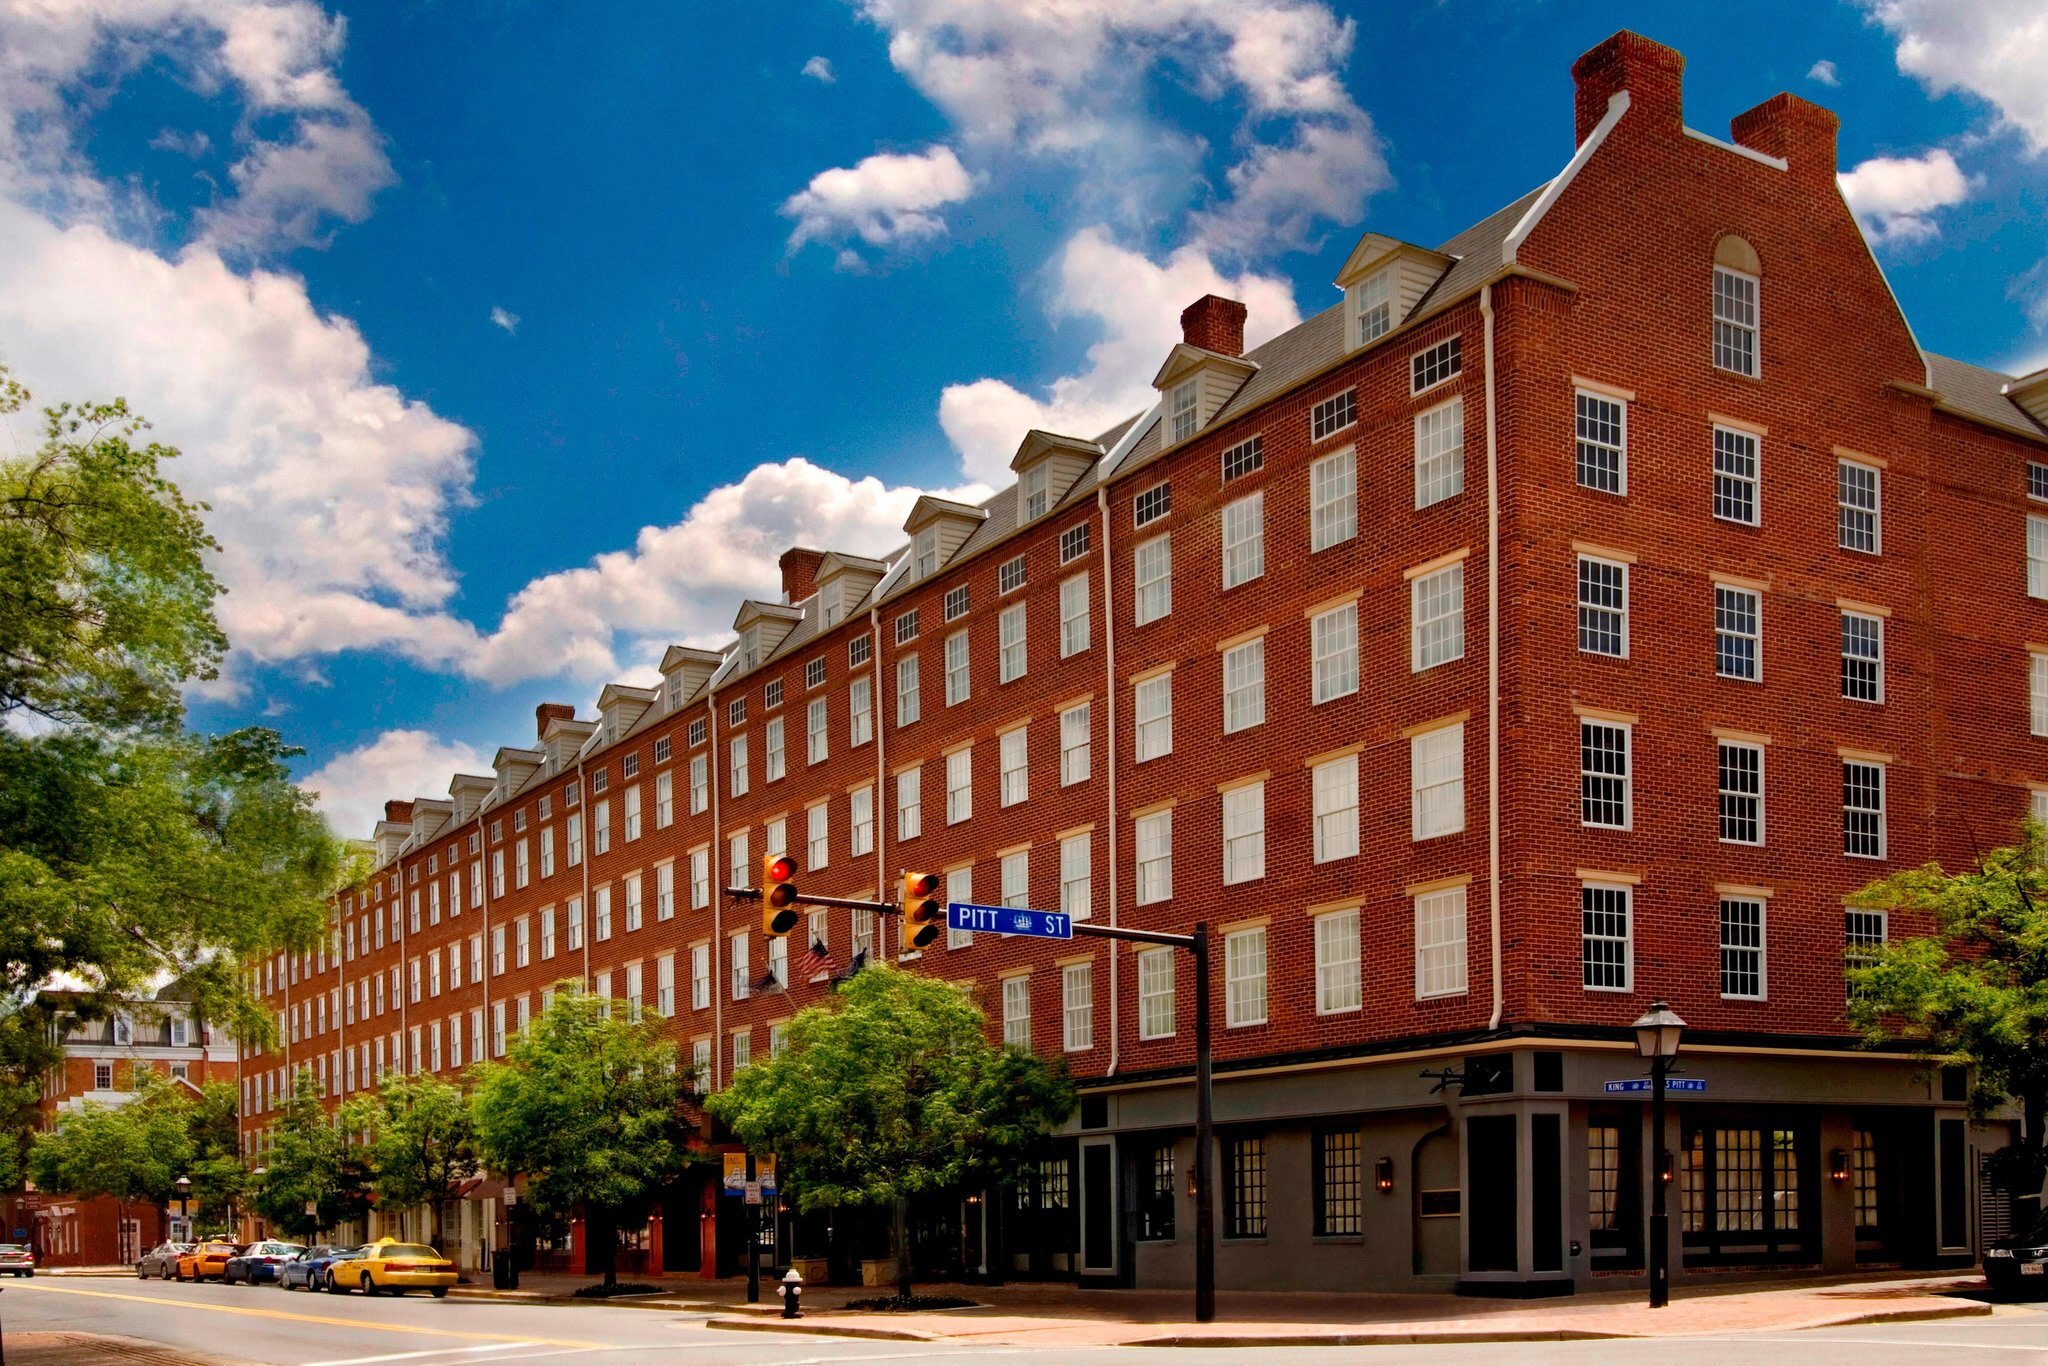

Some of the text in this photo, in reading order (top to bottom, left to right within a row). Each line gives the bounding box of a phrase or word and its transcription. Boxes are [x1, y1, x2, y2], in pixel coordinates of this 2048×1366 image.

[959, 907, 1064, 935] PITT ST
[1608, 1082, 1624, 1091] KING
[1672, 1080, 1685, 1089] PITT
